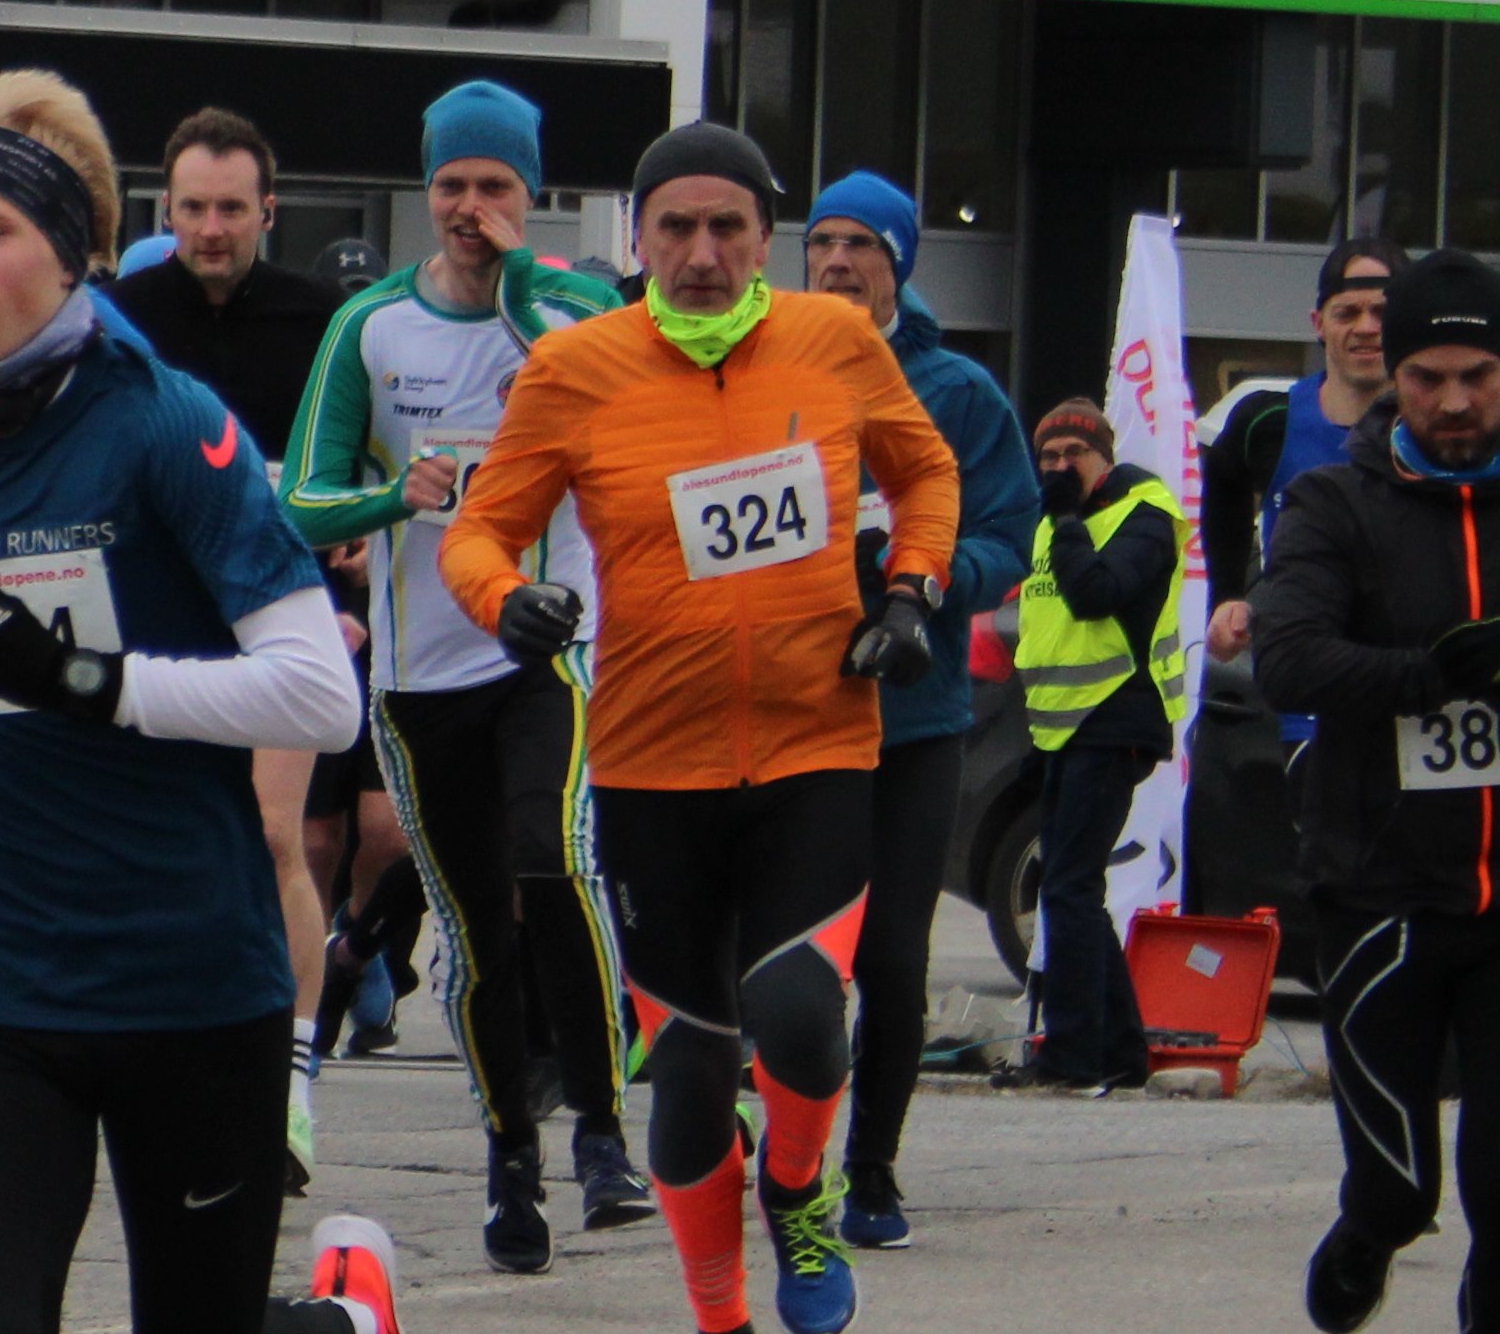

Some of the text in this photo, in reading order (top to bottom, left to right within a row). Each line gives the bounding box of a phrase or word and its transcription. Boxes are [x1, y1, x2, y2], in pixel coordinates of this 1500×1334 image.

[392, 404, 444, 419] TRIMTEX
[7, 522, 117, 555] RUNNERS
[701, 485, 807, 561] 324
[1421, 708, 1500, 773] 38
